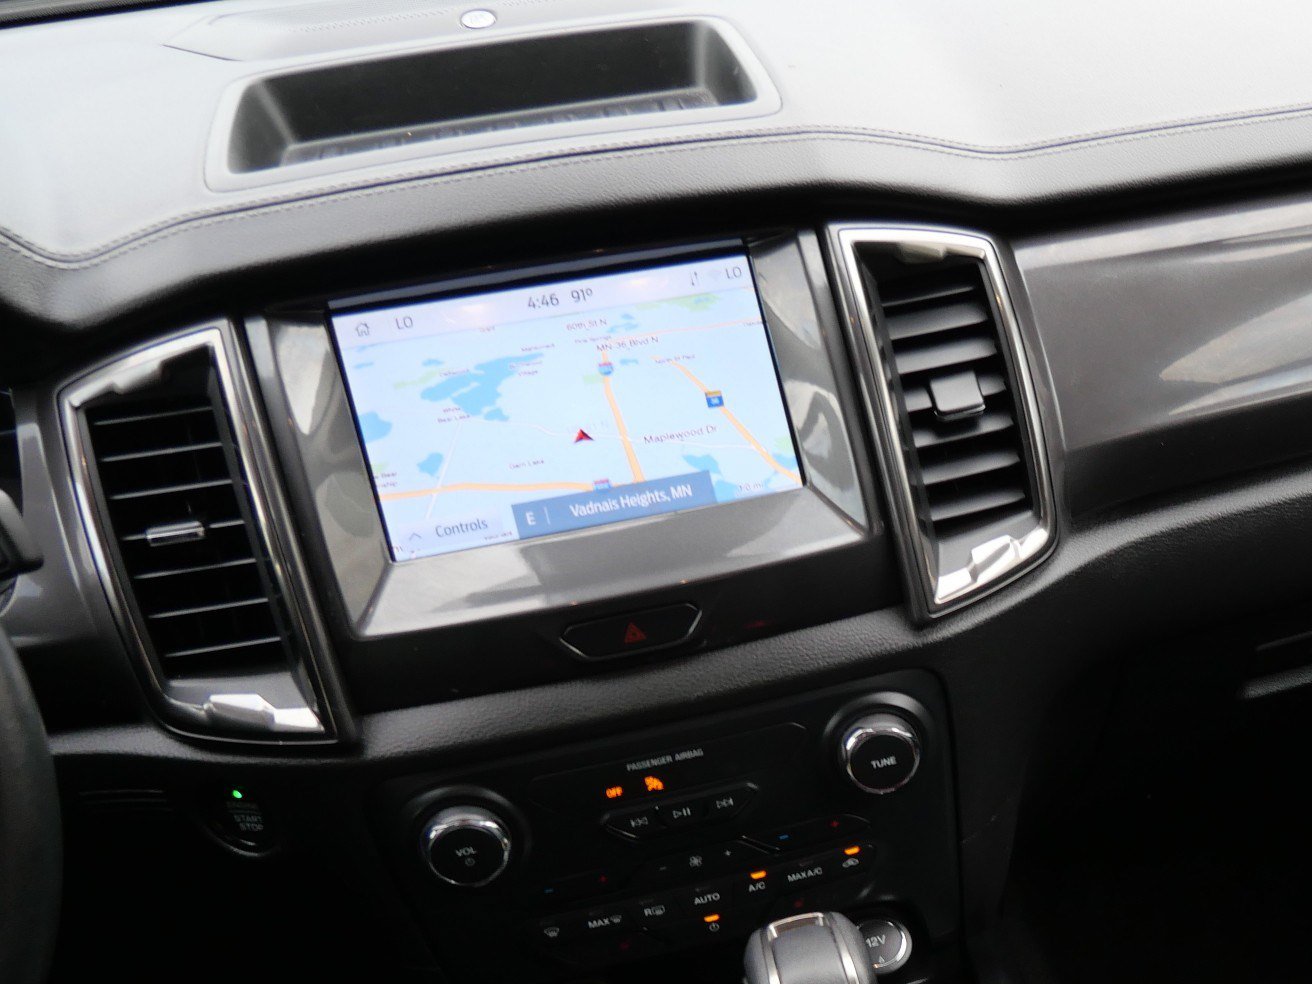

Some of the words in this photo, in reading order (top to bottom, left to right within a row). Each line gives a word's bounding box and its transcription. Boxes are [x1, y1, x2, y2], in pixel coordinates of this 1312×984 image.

[396, 315, 413, 330] LO
[527, 292, 560, 310] 4:46
[725, 266, 742, 280] LO
[643, 426, 703, 445] Maplewood
[525, 511, 537, 527] E
[569, 499, 620, 519] Vadnais
[620, 487, 672, 510] Heights,
[671, 483, 693, 500] MN
[434, 518, 489, 539] Controls
[626, 755, 673, 772] PASSENGER
[675, 748, 704, 762] AIRBAG
[870, 755, 898, 769] TUNE
[605, 785, 623, 799] OFF
[455, 845, 478, 858] VOL
[748, 881, 766, 893] A/C
[694, 892, 721, 906] AUTO
[588, 917, 611, 929] MAX
[865, 934, 886, 948] 12V
